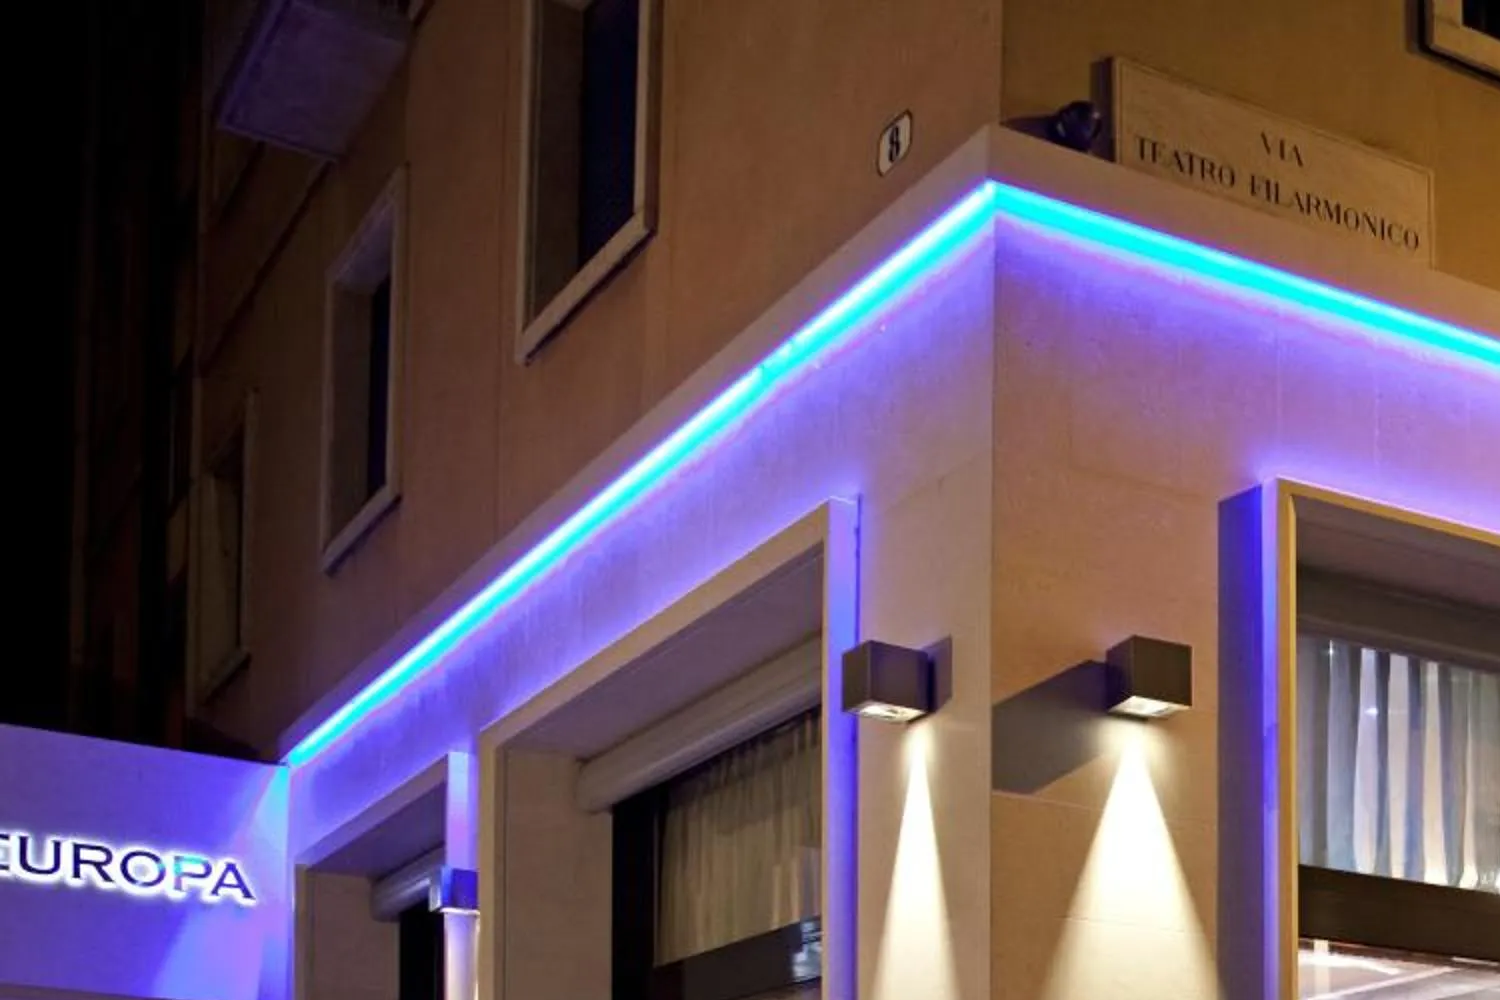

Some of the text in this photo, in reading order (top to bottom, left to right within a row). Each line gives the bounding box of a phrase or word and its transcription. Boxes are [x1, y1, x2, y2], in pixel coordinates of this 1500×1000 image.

[888, 125, 901, 163] 8
[1259, 131, 1305, 168] VIA
[1133, 134, 1420, 251] TEATRO FILARMONICO
[0, 832, 256, 901] UROPA
